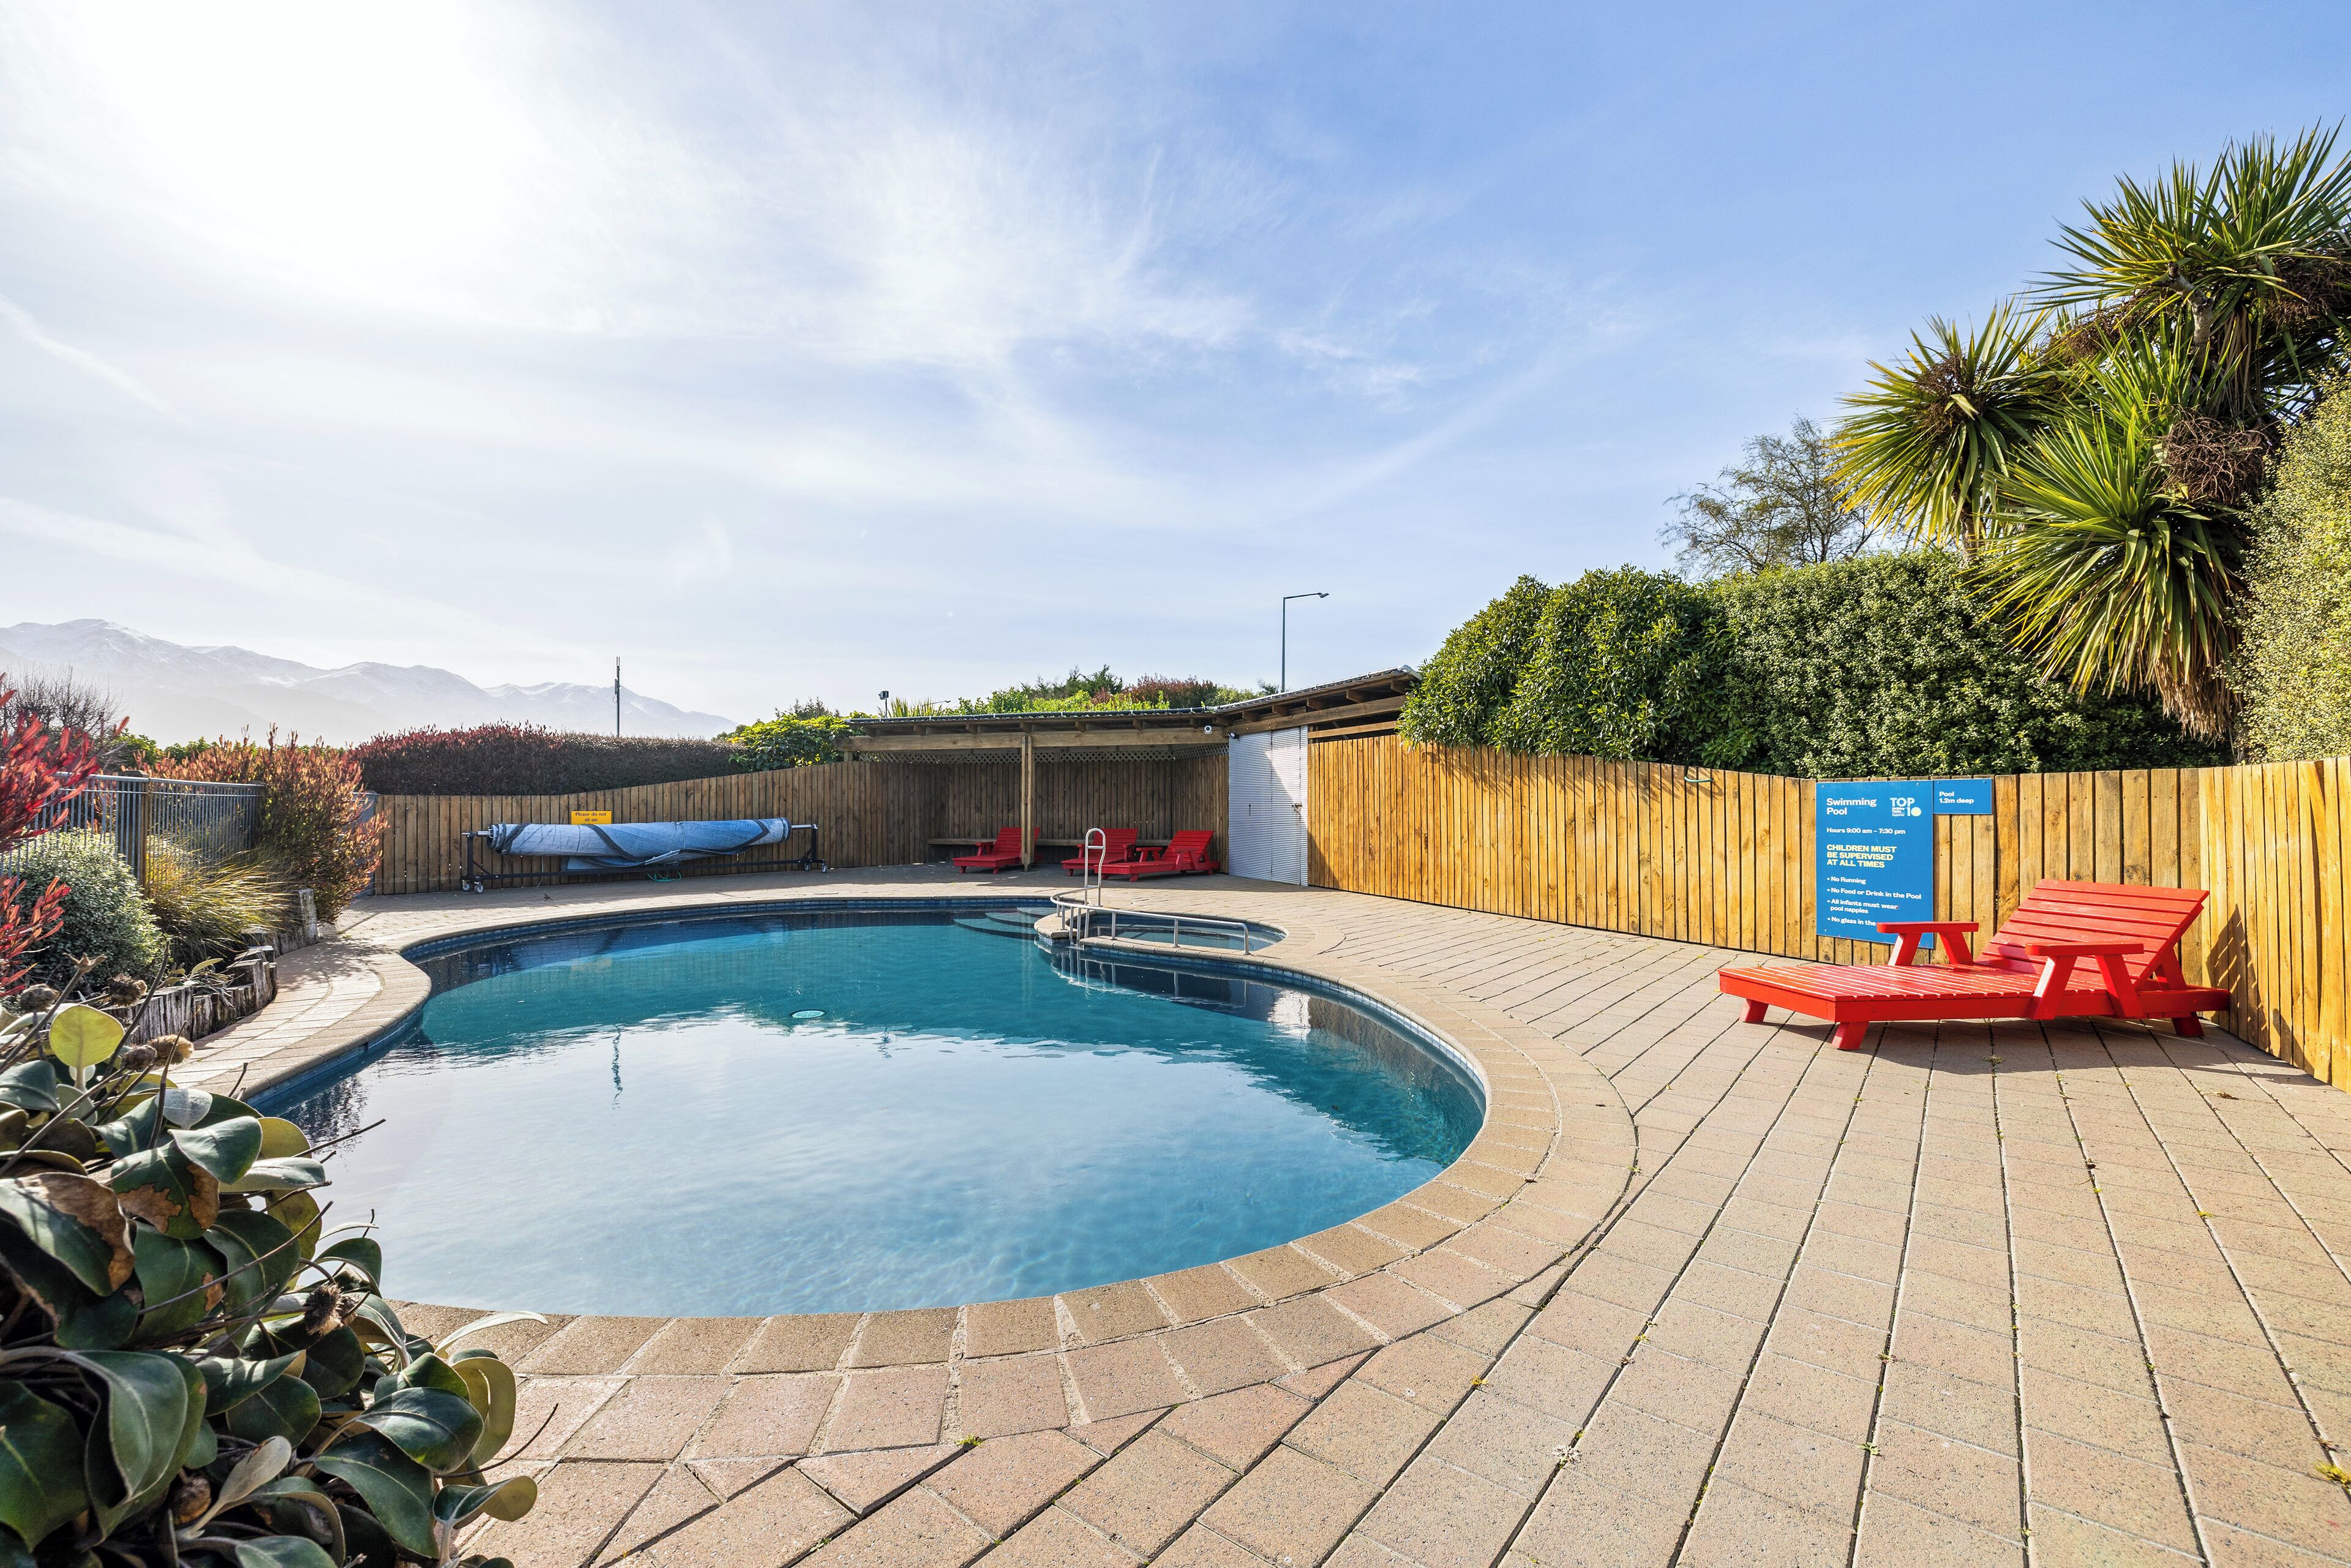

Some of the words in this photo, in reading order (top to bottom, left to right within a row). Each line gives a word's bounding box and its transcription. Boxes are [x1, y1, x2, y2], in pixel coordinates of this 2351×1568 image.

[1826, 797, 1877, 808] Swimming
[1890, 797, 1915, 807] TOP
[1839, 852, 1894, 861] SUPERVISED
